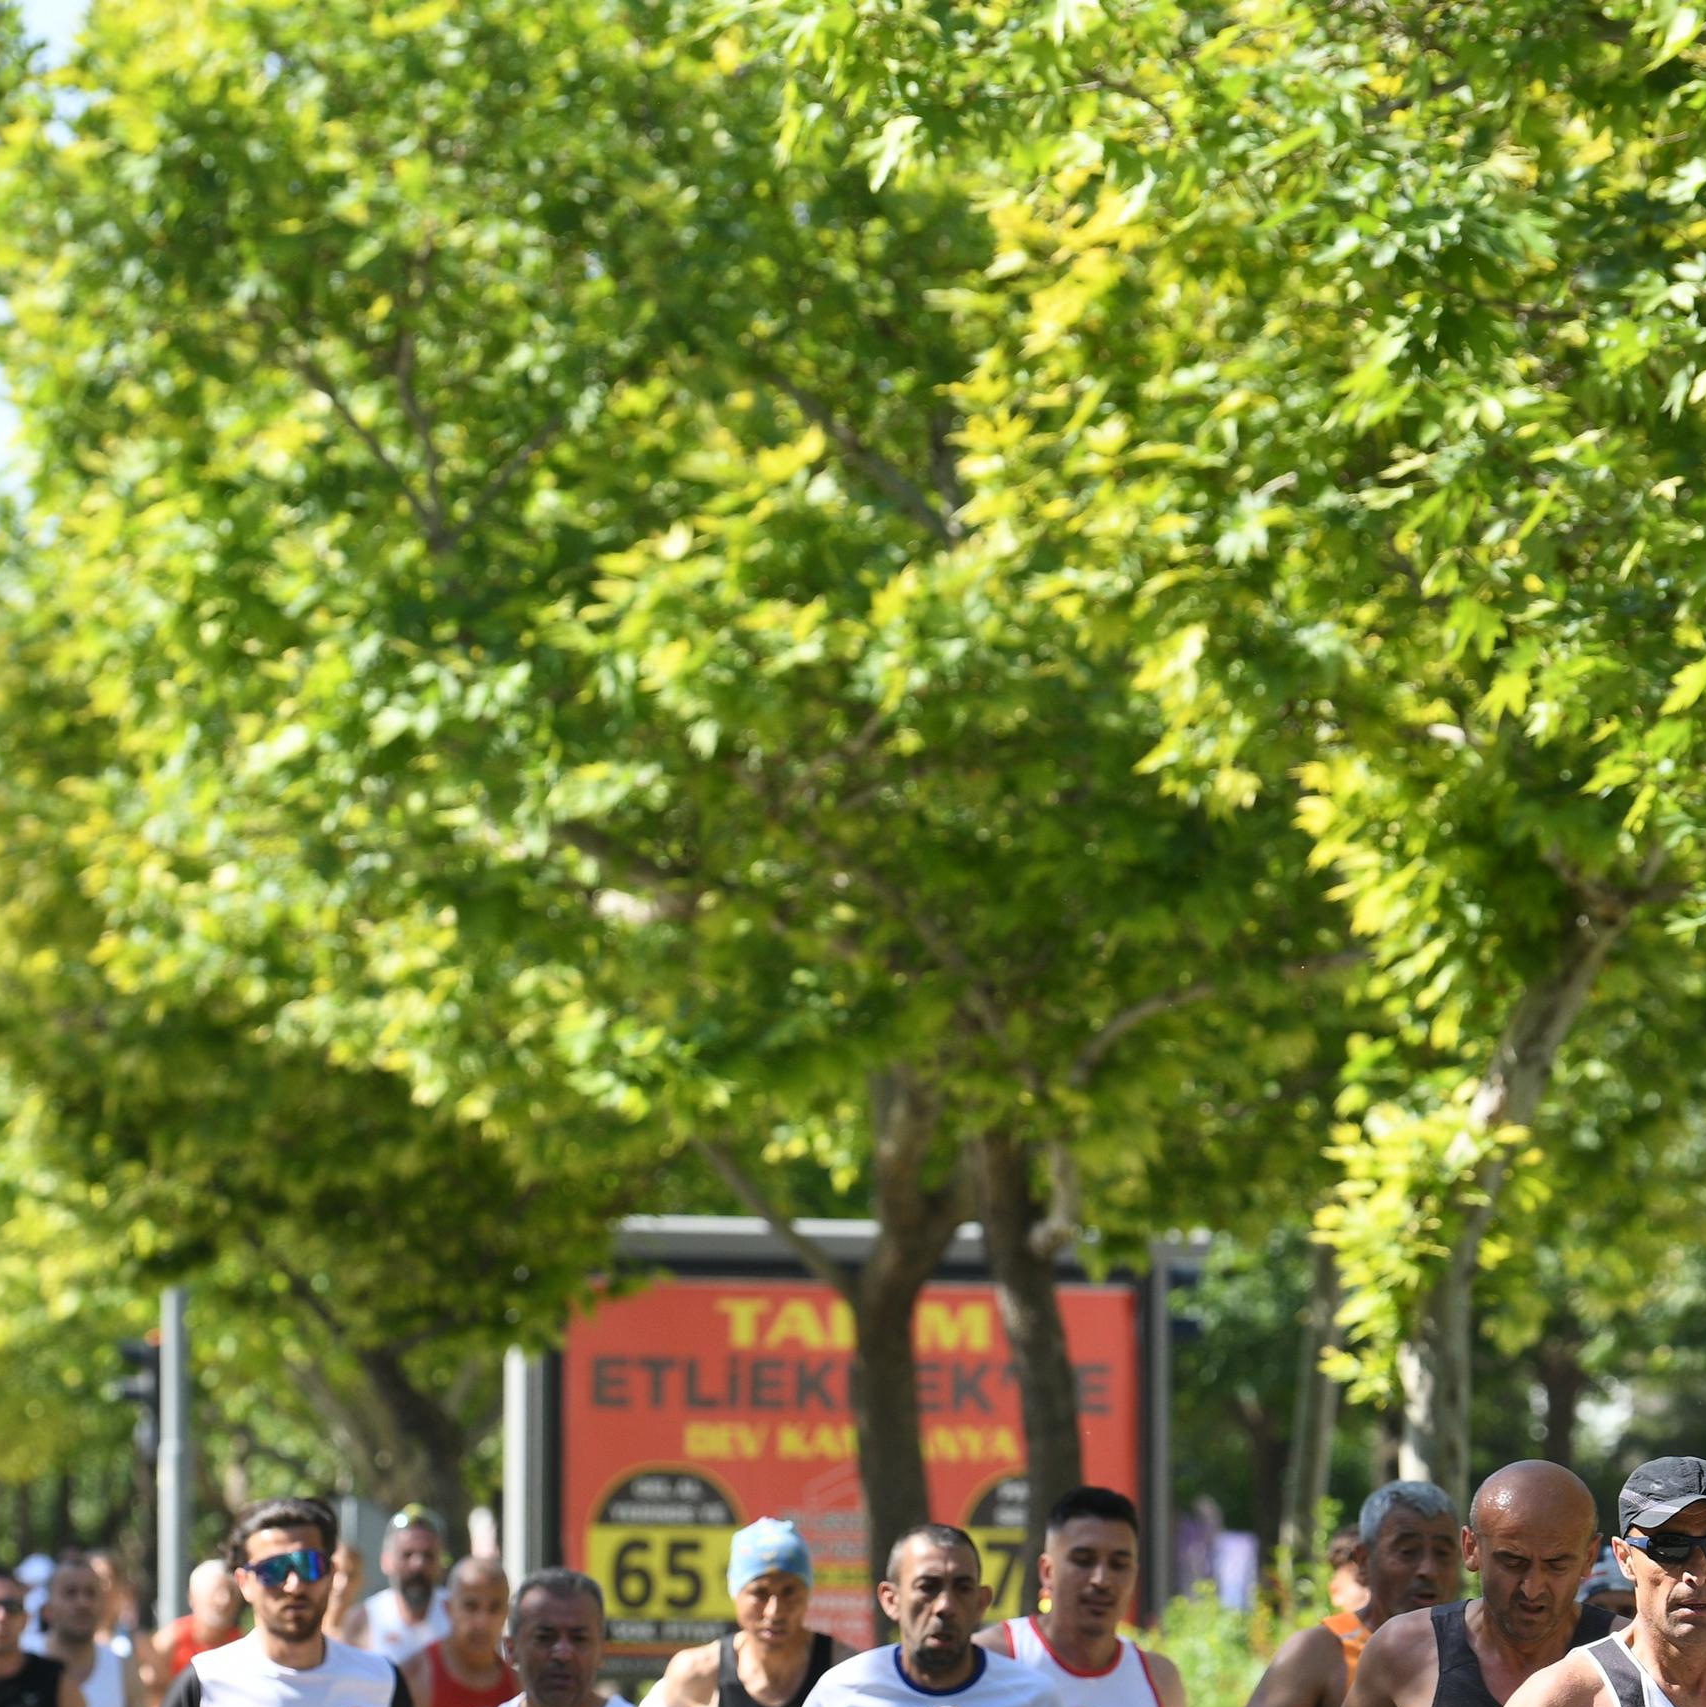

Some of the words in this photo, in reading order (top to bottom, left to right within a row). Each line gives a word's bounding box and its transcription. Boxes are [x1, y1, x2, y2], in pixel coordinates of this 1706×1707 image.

[715, 1297, 991, 1352] TAM
[592, 1352, 1111, 1415] ETLİEKEK'E
[611, 1537, 704, 1609] 65
[987, 1541, 1023, 1609] 7
